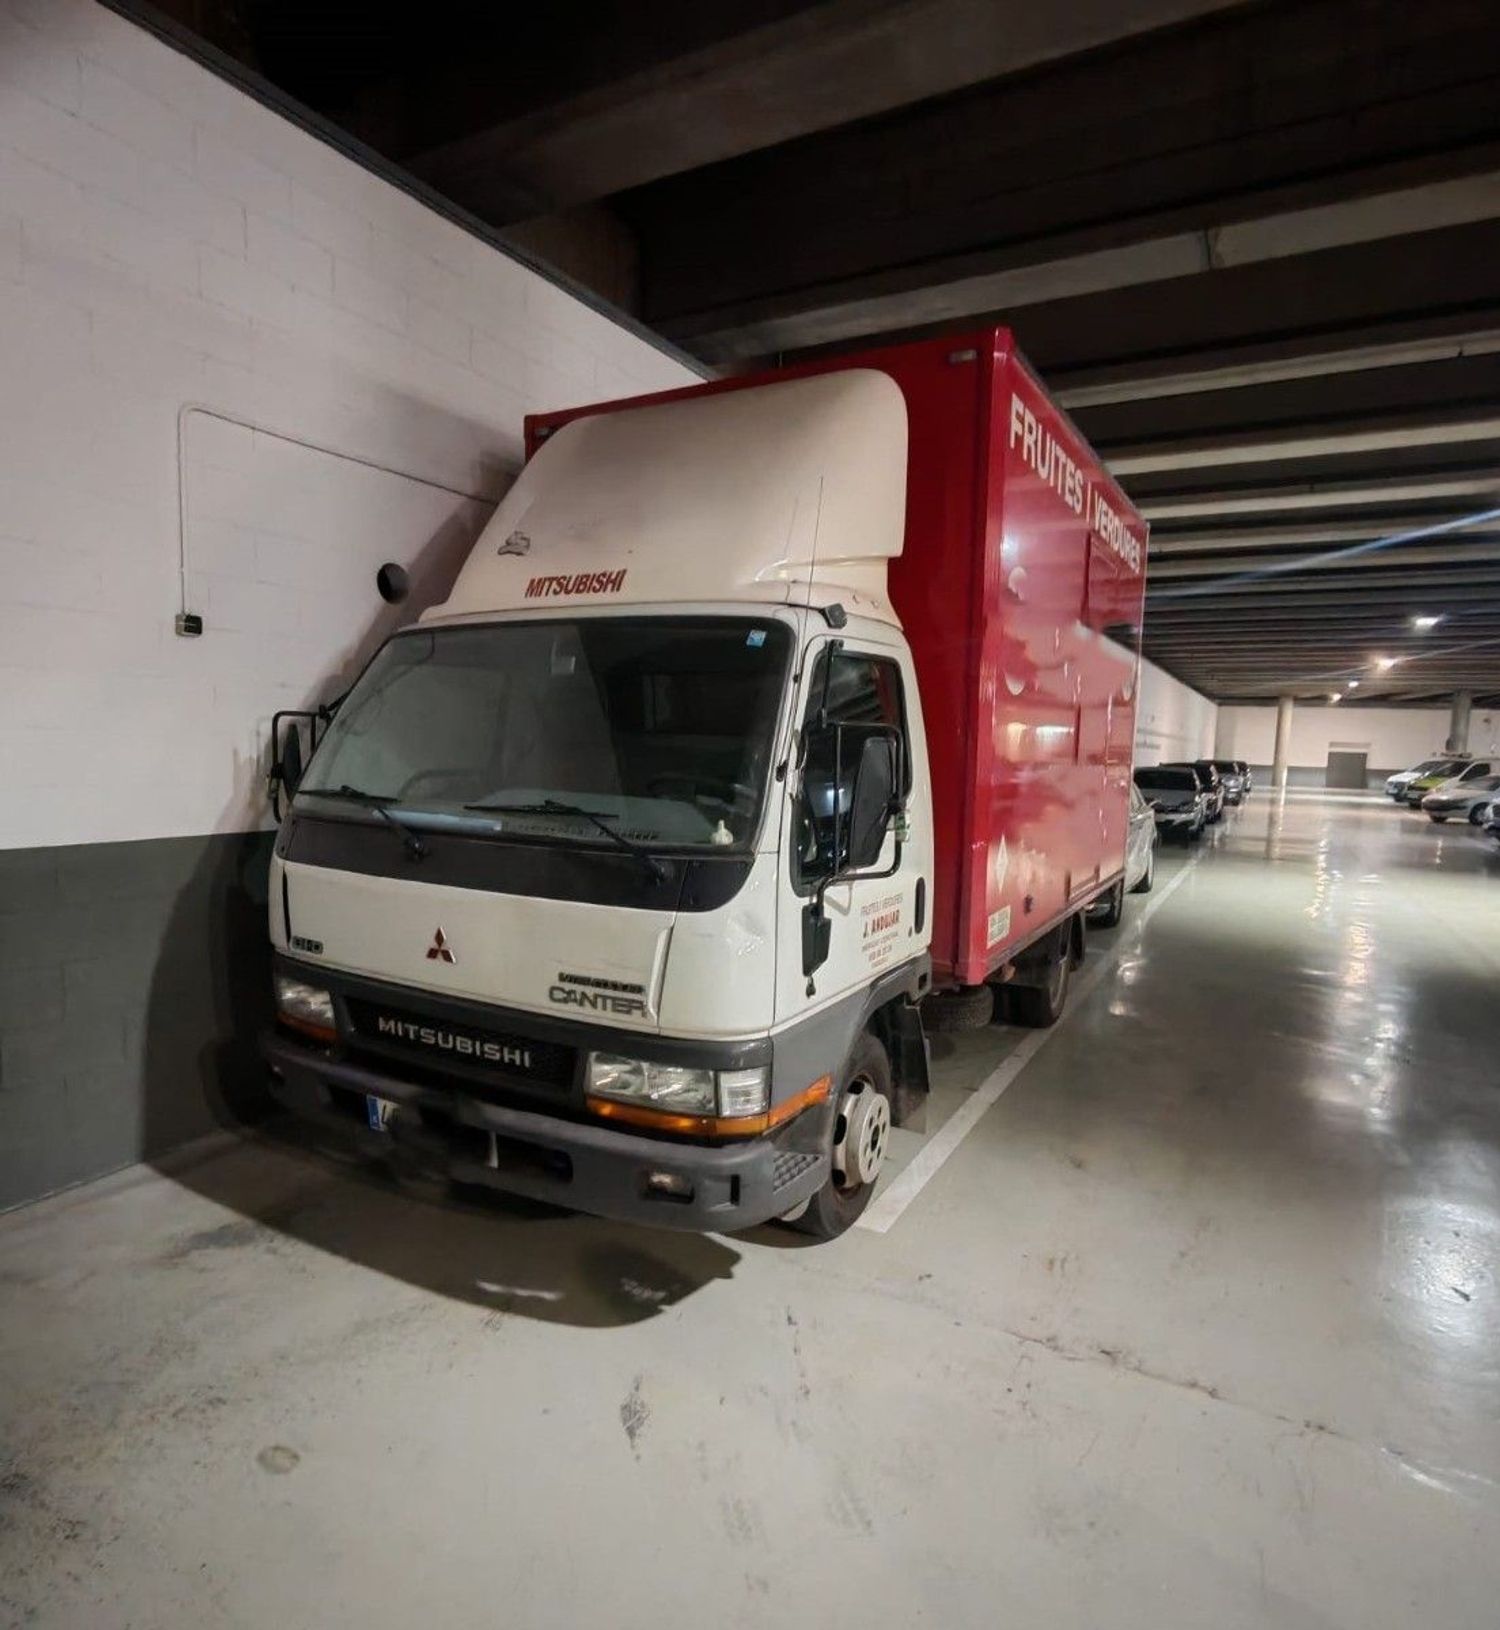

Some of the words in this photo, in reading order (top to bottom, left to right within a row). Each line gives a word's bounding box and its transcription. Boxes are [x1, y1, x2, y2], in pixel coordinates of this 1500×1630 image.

[1010, 392, 1084, 514] FRUITES
[1094, 491, 1140, 575] VERDURES
[525, 569, 628, 598] MITSUBISHI
[549, 985, 647, 1018] CANTER
[378, 1017, 531, 1068] MITSUBISHI
